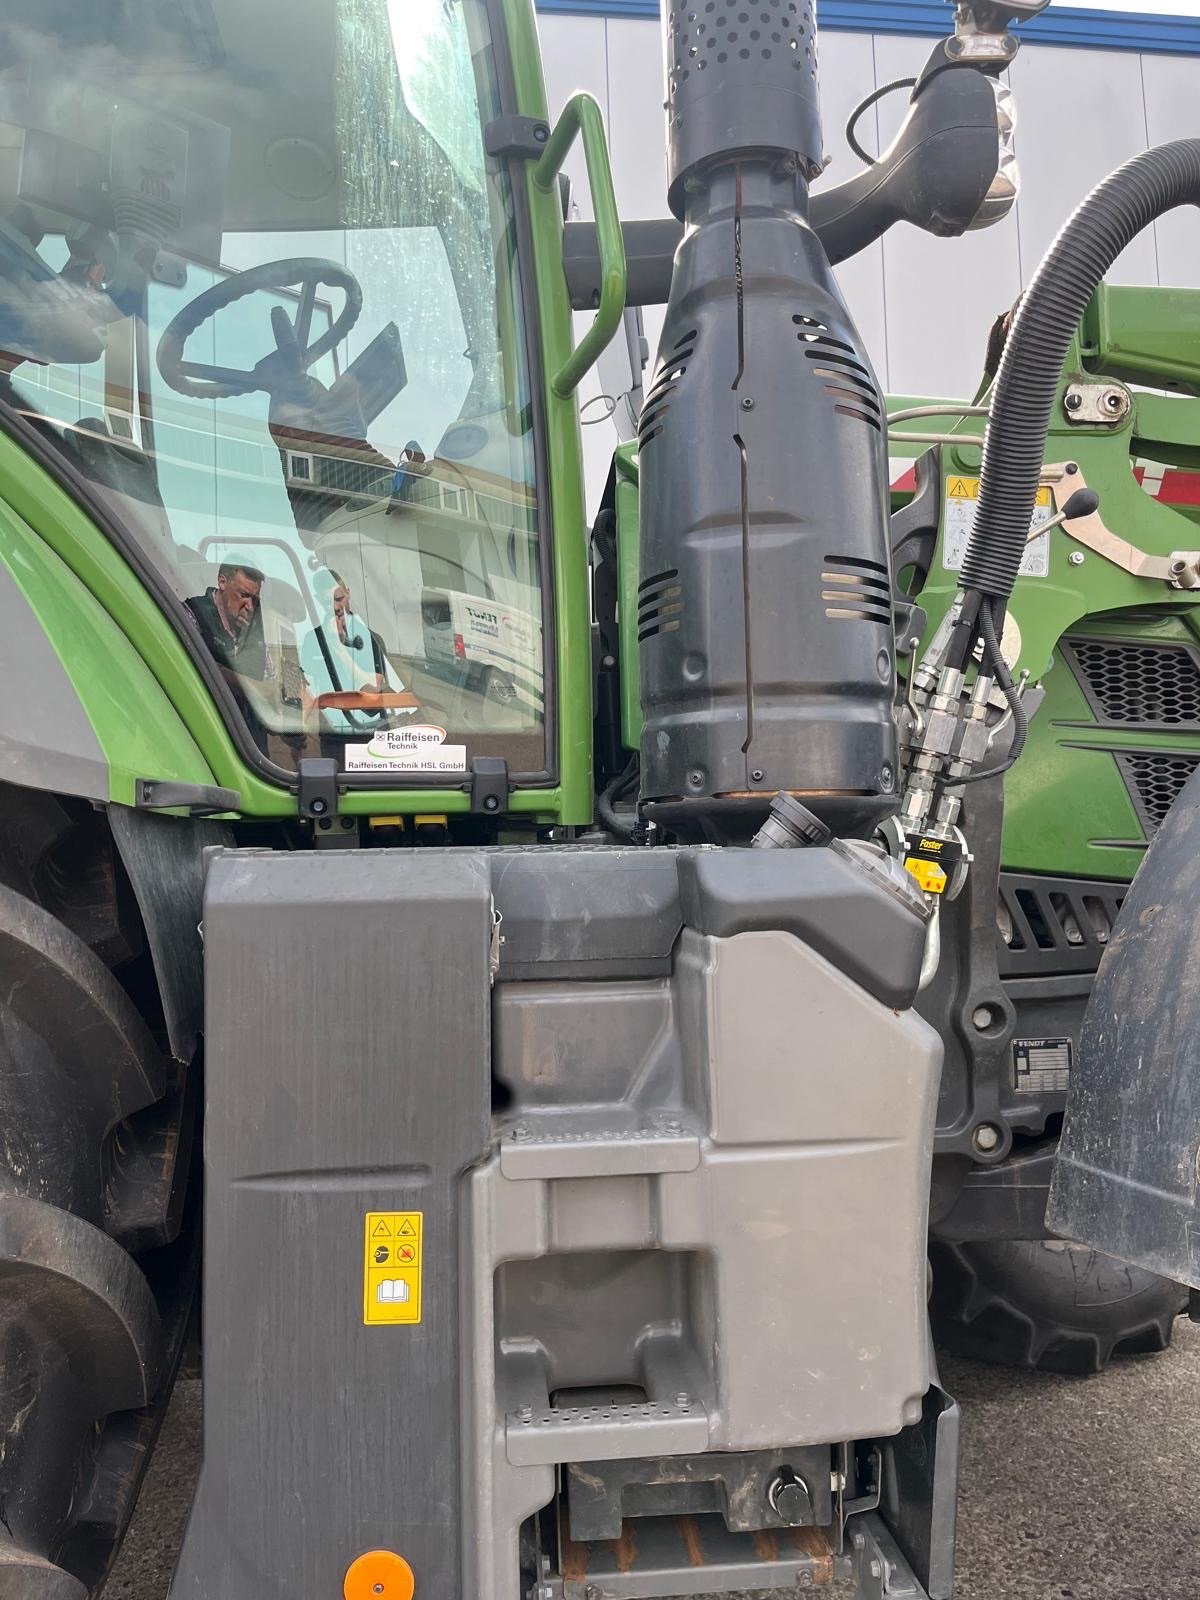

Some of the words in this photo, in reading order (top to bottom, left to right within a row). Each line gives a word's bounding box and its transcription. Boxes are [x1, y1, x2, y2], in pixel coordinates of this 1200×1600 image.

[387, 732, 440, 742] Raiffeisen
[388, 742, 418, 750] Technik
[348, 761, 388, 769] Raiffeisen
[389, 761, 419, 769] Technik
[439, 762, 464, 770] GmbH
[919, 839, 944, 850] Foster
